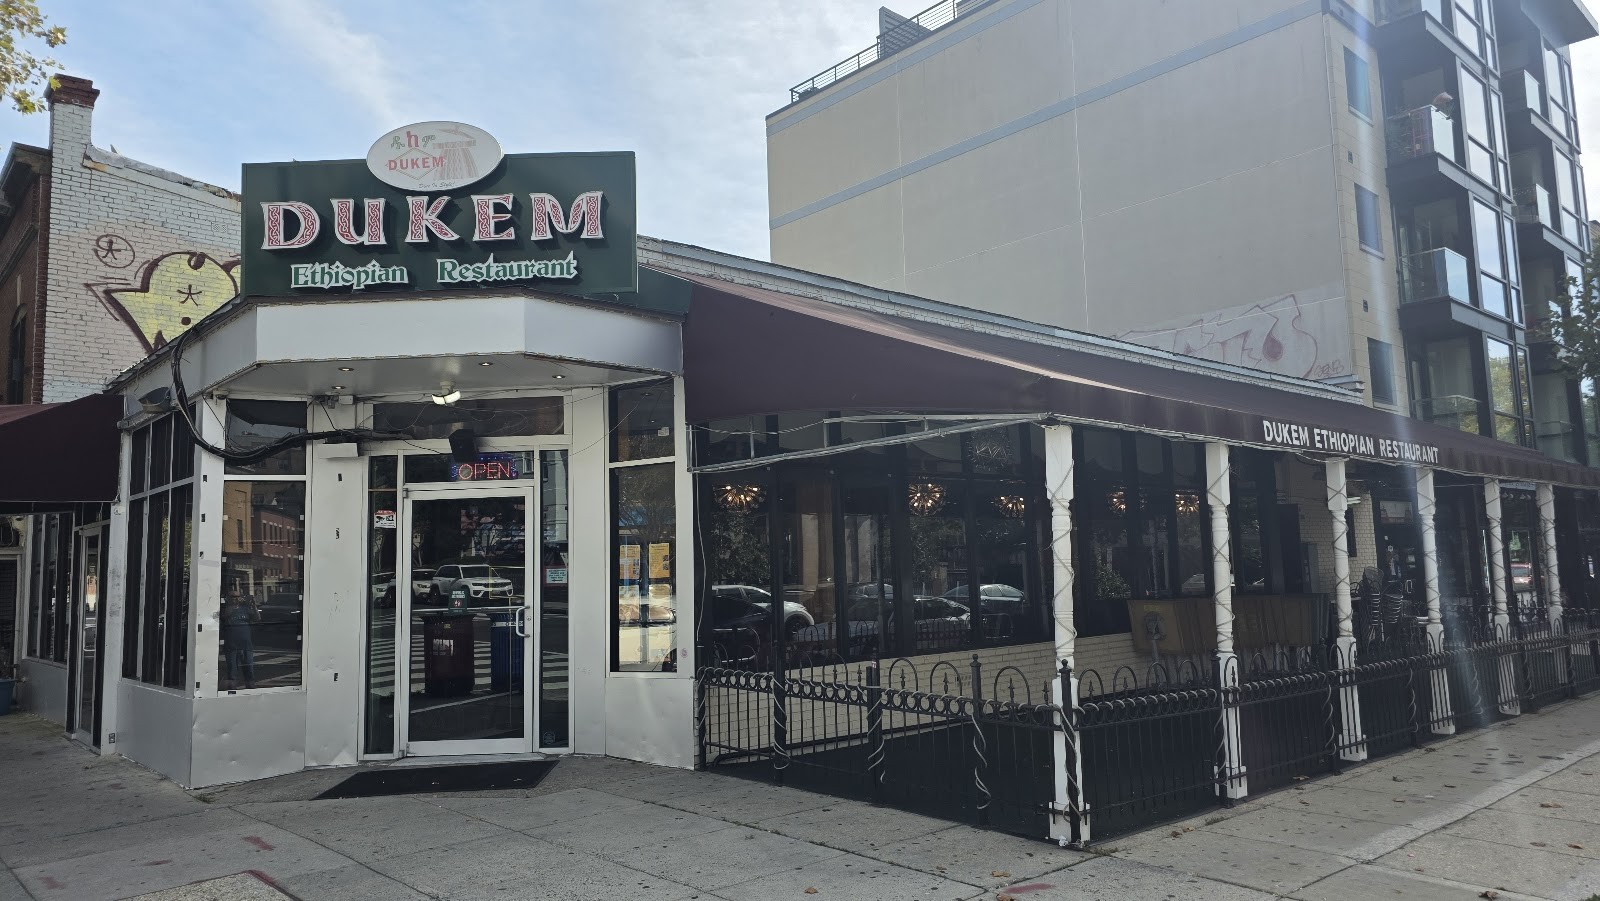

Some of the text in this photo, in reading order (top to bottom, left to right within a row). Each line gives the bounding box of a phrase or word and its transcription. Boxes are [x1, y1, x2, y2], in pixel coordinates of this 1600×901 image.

[388, 156, 445, 170] DUKEM
[260, 191, 604, 250] DUKEM
[290, 251, 578, 290] Ethiopian Restaurant
[1263, 420, 1439, 463] DUKEM ETHIOPIAN RESTAURANT
[458, 462, 510, 479] OPEN
